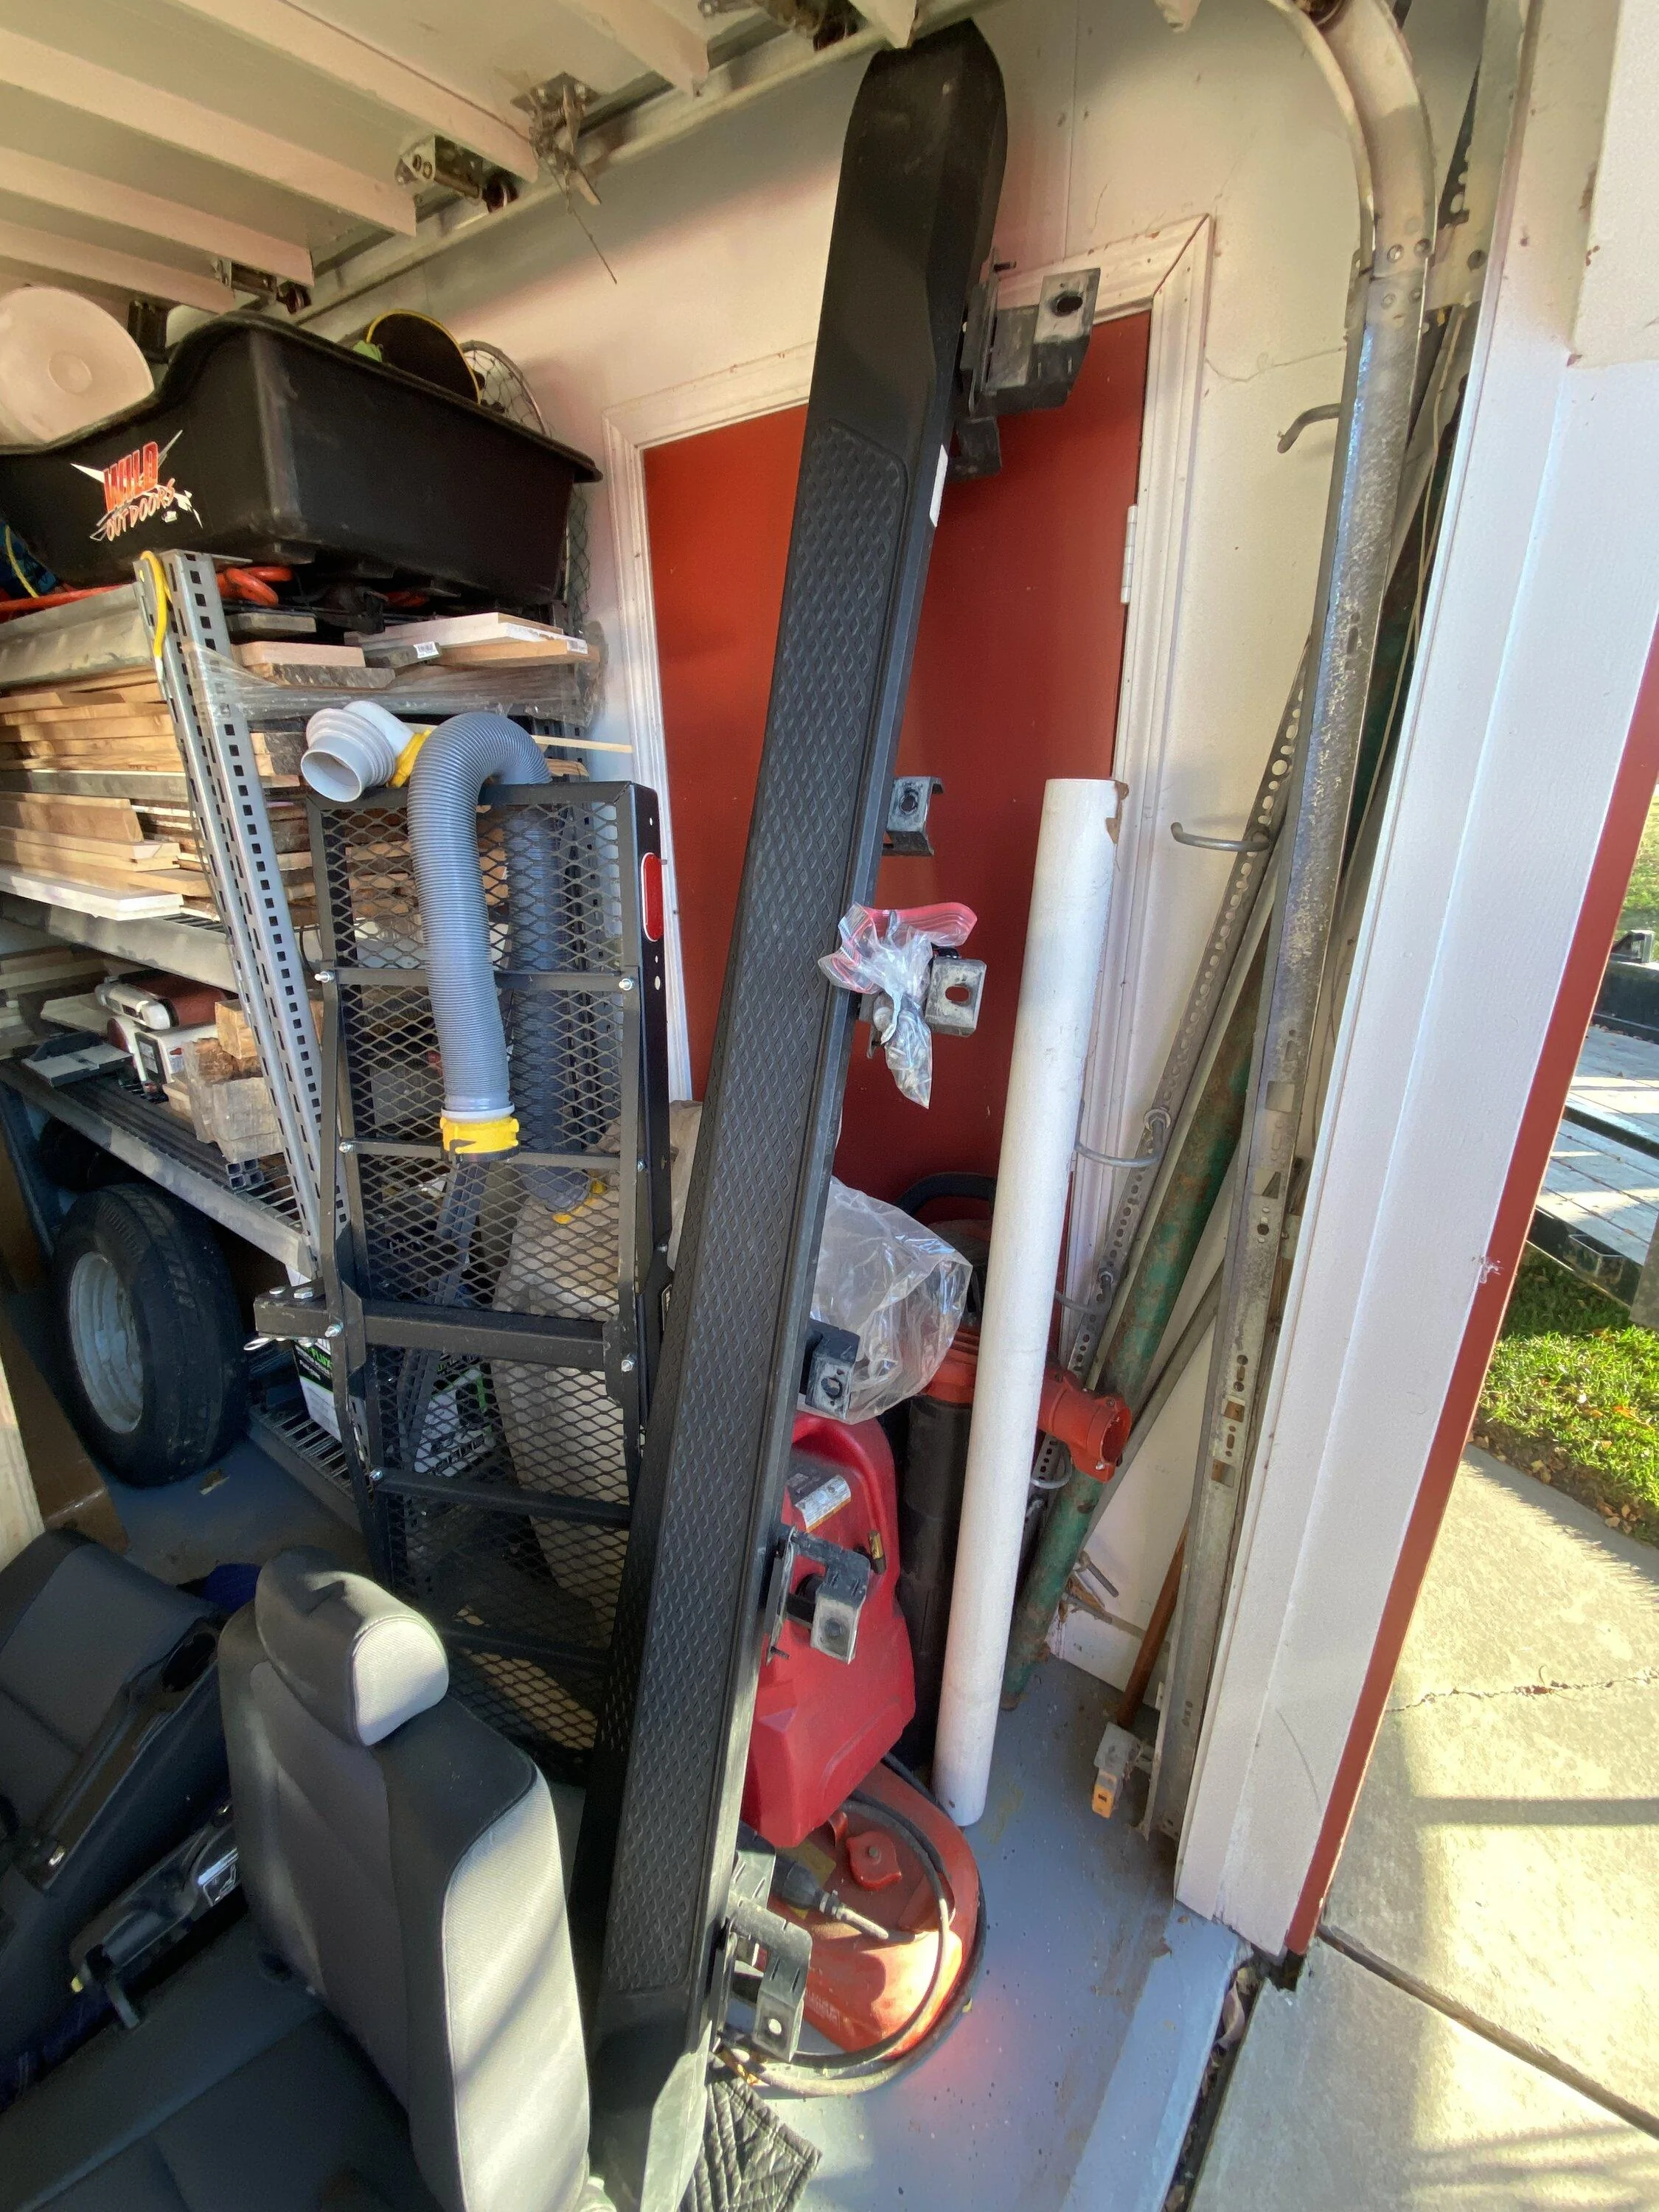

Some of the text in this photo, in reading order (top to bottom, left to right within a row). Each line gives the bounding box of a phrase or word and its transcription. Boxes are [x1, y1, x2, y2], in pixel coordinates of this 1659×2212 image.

[104, 442, 159, 513] WILD
[105, 477, 176, 542] OUTDOORS
[309, 1346, 333, 1370] FLUX
